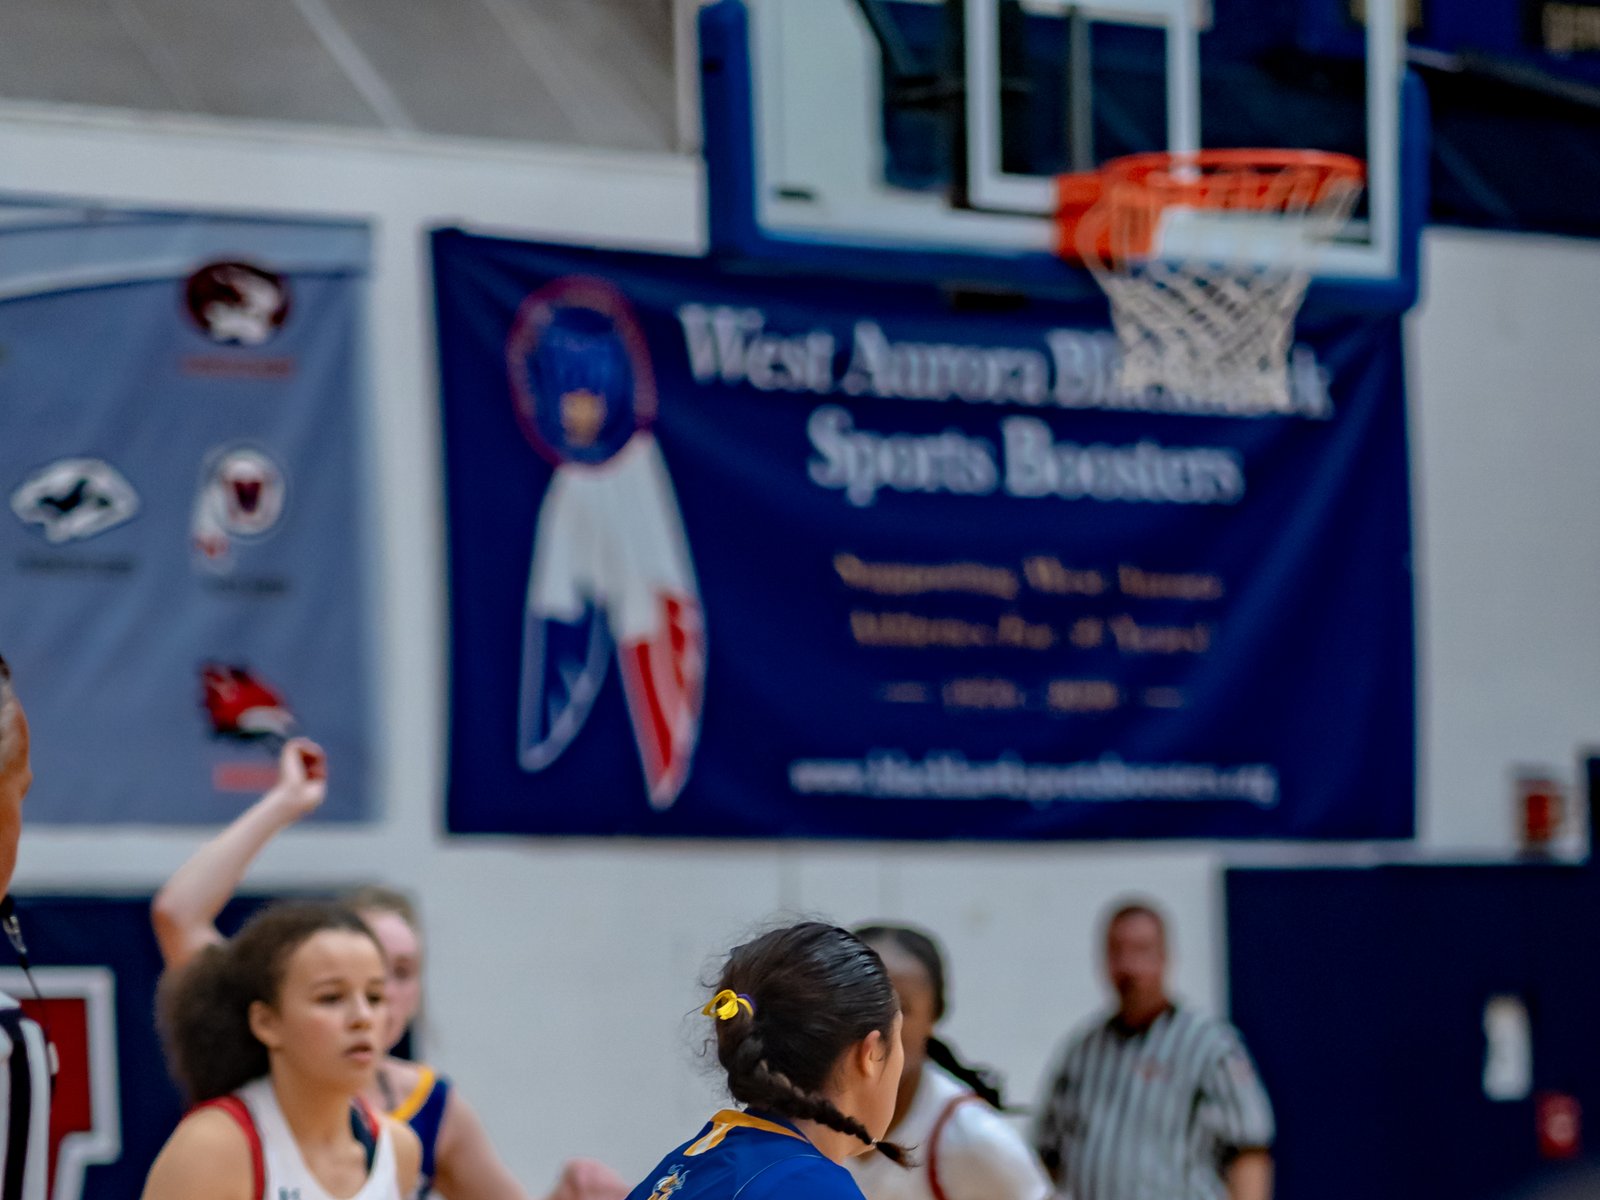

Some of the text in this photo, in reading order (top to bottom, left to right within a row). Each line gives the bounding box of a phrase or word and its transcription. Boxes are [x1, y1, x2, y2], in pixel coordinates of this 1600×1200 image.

[679, 303, 834, 395] West
[842, 320, 1047, 403] Aurora
[808, 404, 1245, 505] Sports Boosters
